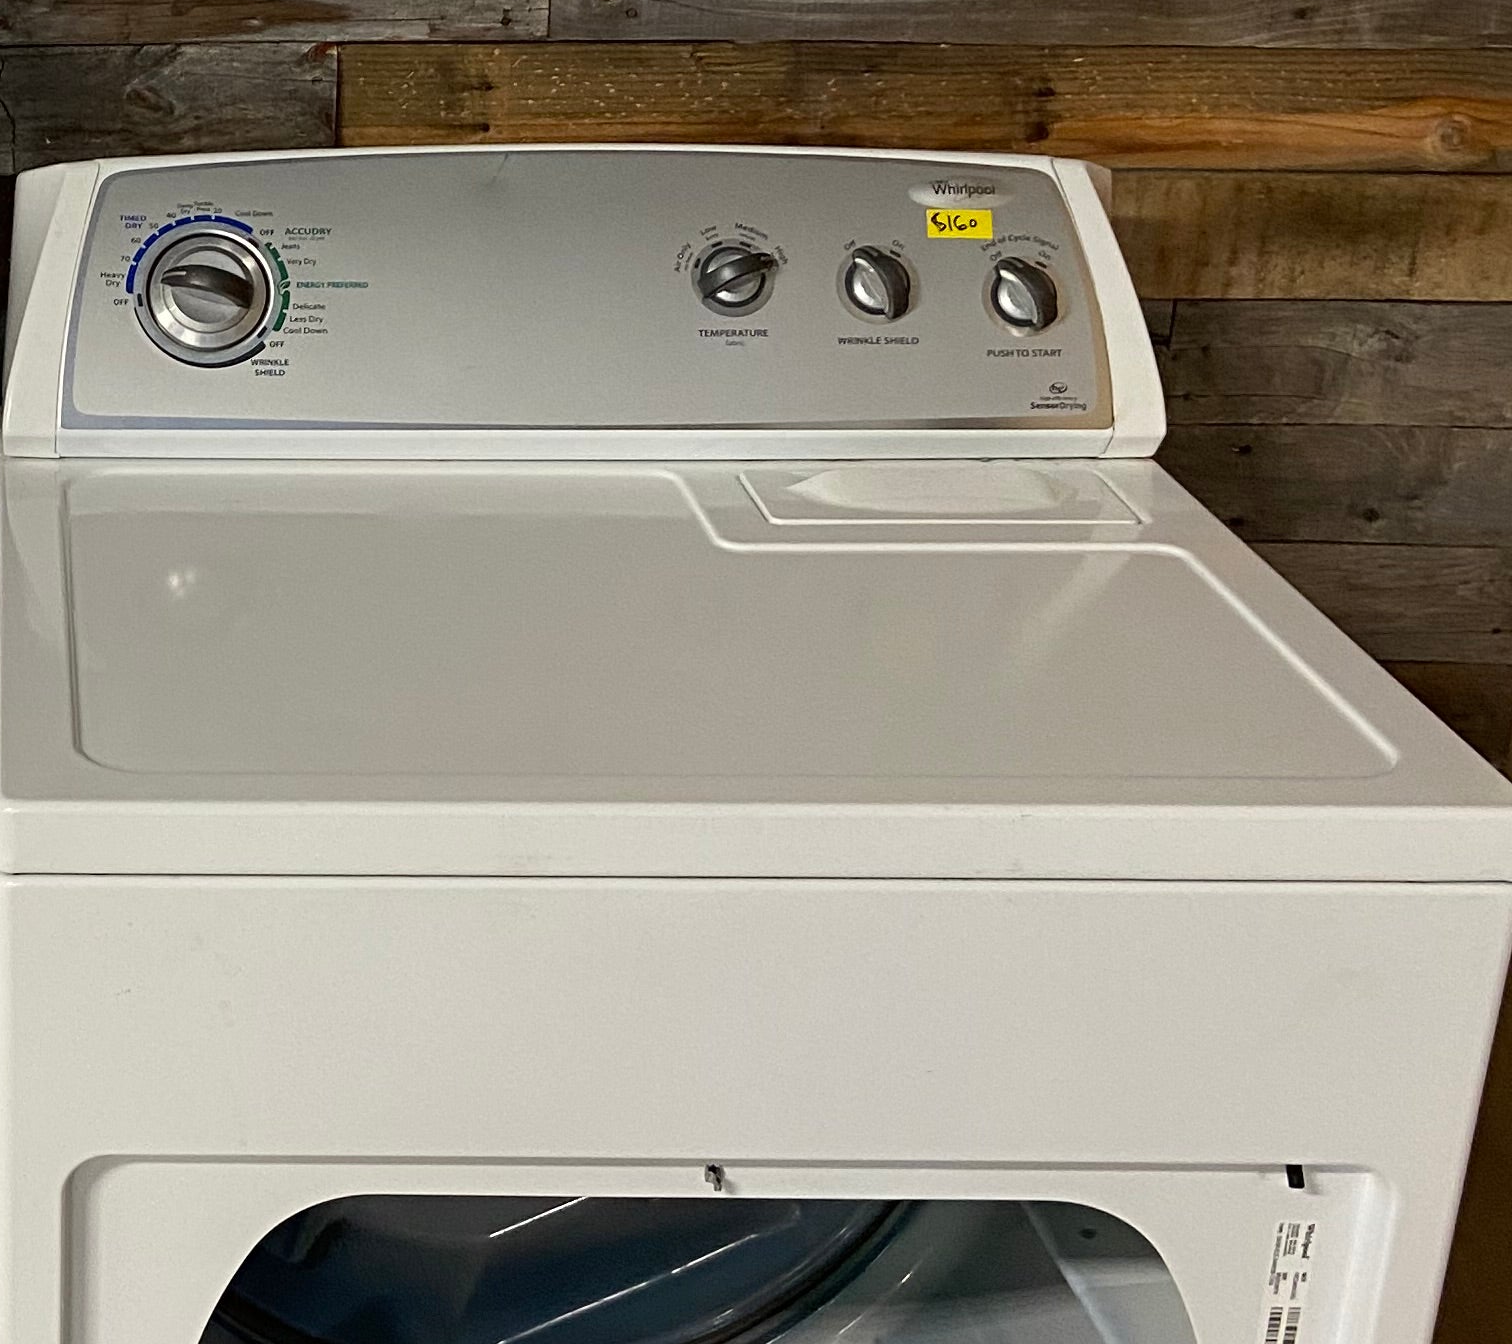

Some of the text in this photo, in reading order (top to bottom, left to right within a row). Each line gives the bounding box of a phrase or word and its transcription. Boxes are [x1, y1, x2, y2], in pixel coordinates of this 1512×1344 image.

[932, 184, 996, 198] Whirlpool
[259, 228, 275, 236] OFF
[284, 227, 332, 235] ACCUDRY
[303, 258, 317, 266] Dry
[100, 271, 125, 280] Heavy
[105, 279, 122, 288] Dry
[113, 298, 130, 306] OFF
[289, 315, 324, 325] Less Dry
[698, 329, 769, 337] TEMPERATURE
[986, 348, 1063, 357] PUSH TO START
[250, 358, 290, 366] WRINKLE
